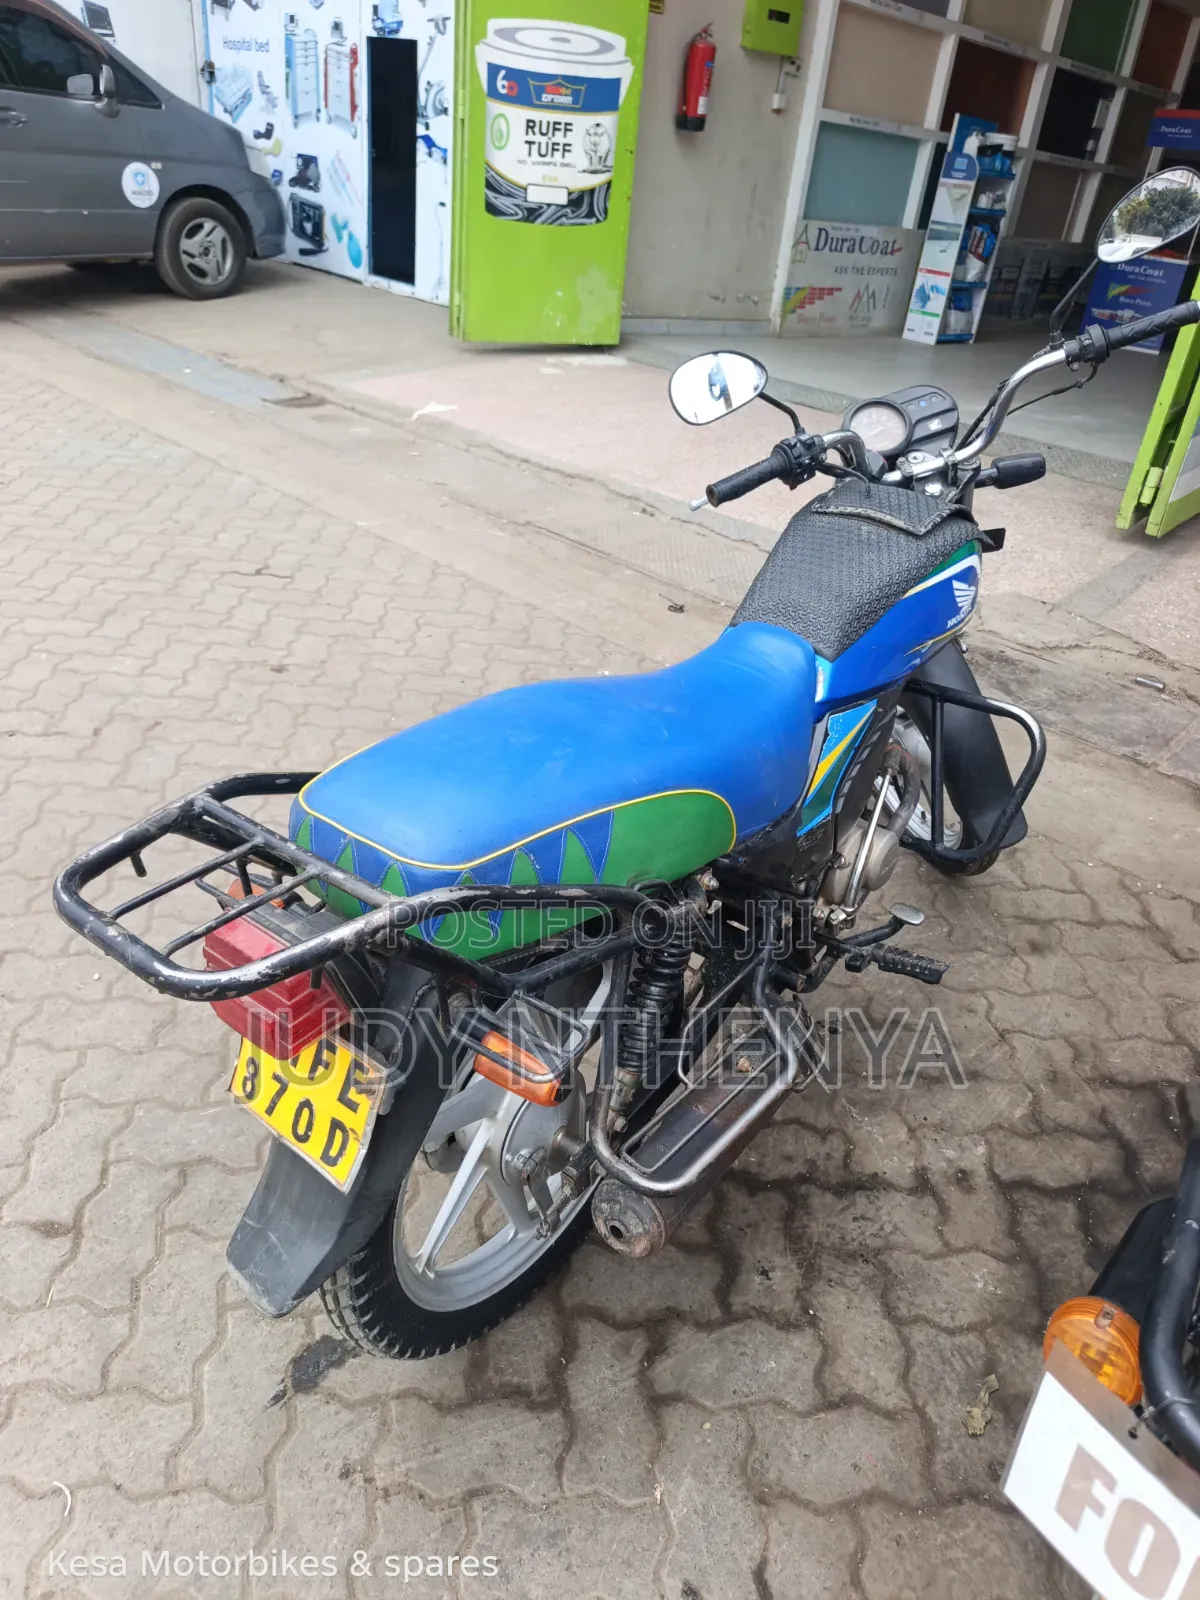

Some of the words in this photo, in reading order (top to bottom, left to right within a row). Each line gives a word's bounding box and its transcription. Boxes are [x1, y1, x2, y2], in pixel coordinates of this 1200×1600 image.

[223, 35, 252, 53] Hospital
[255, 38, 270, 53] bed
[525, 119, 574, 138] RUFF
[524, 140, 573, 159] TUFF
